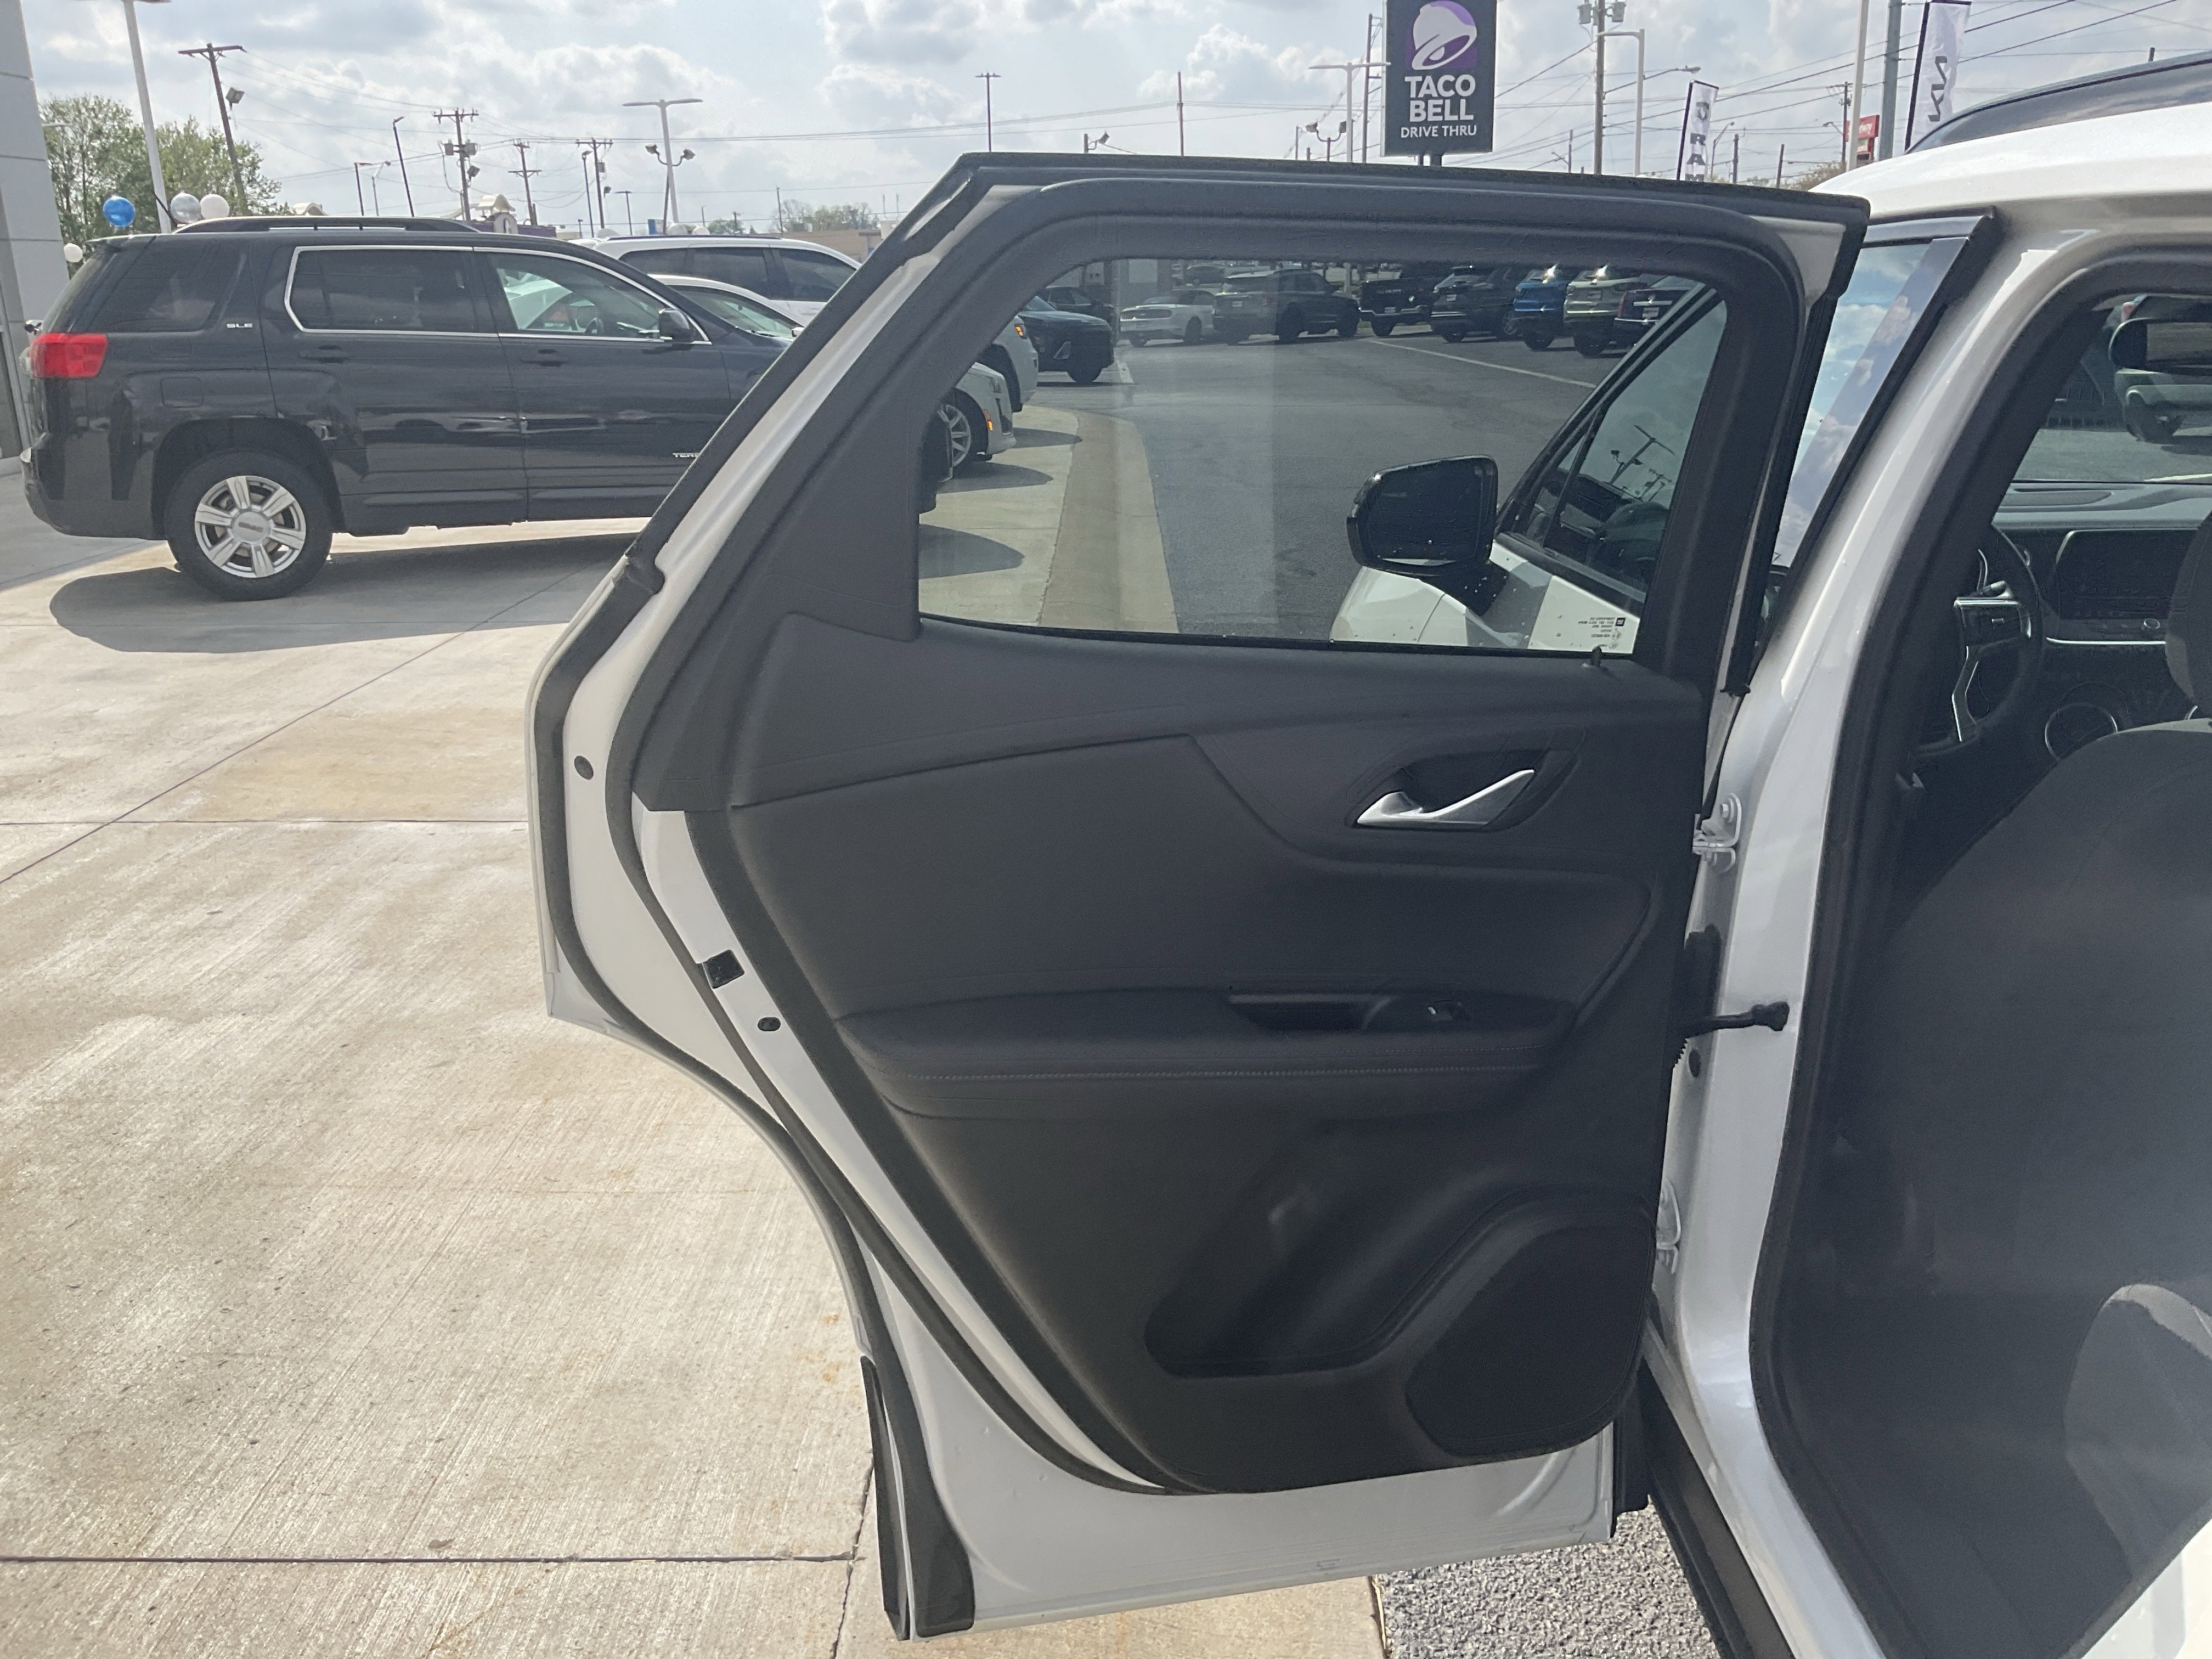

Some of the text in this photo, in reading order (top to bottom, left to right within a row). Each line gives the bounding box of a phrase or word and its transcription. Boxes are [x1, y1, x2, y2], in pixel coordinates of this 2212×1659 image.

[1404, 74, 1476, 98] TACO
[1409, 99, 1474, 122] BELL
[1401, 125, 1477, 138] DRIVE THRU
[1685, 133, 1706, 182] RAM
